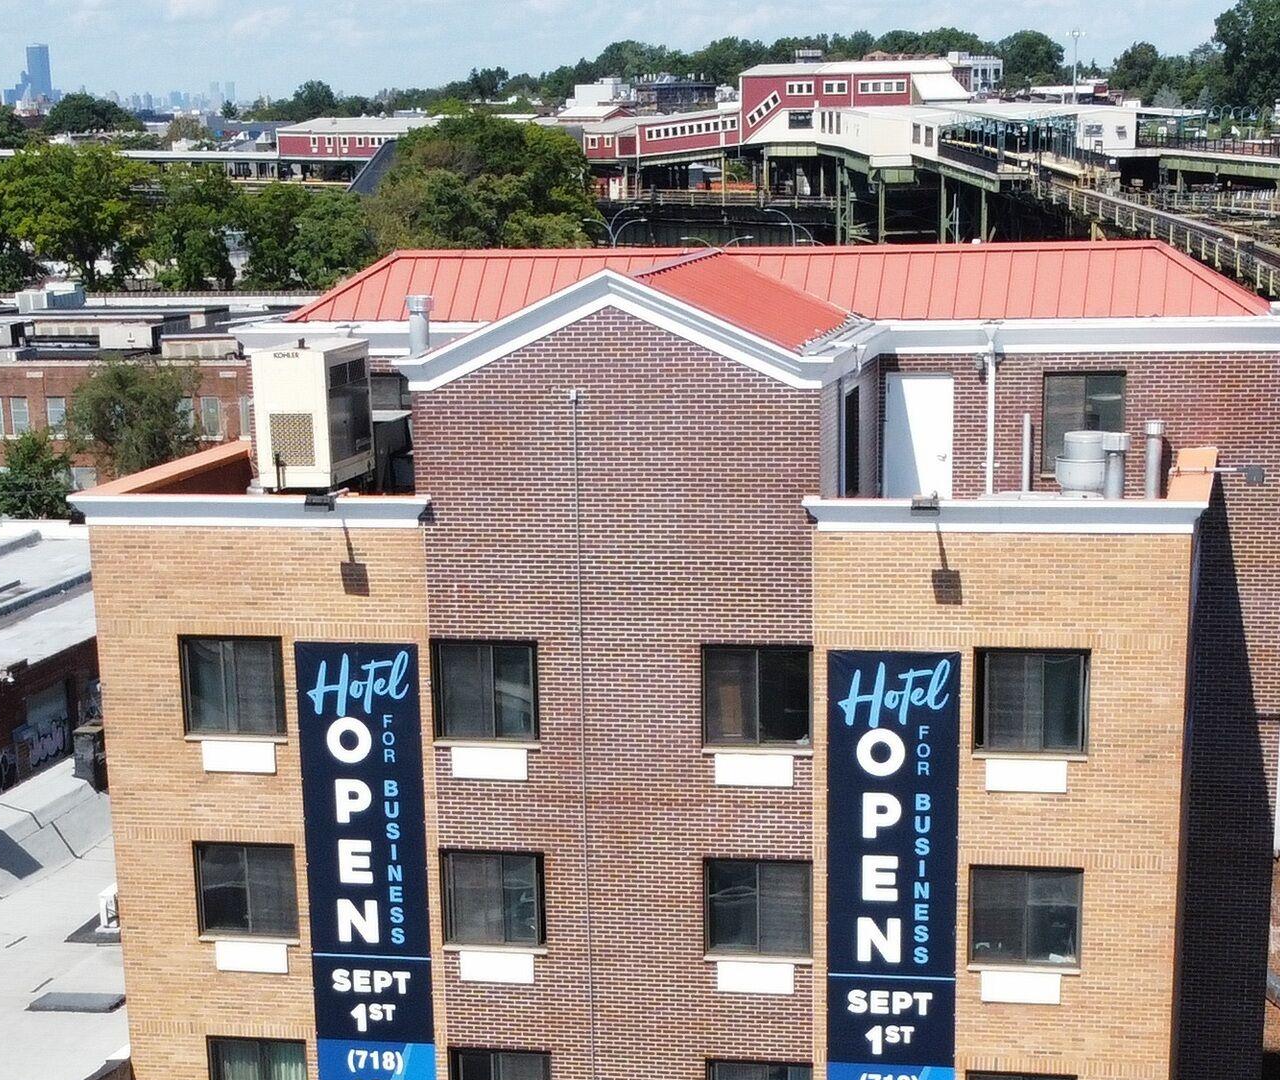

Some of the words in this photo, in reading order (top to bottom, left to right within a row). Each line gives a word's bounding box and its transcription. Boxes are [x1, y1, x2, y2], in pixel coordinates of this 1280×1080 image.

[306, 650, 410, 717] Hotel
[837, 659, 951, 728] Hotel
[382, 714, 396, 763] FOR
[916, 725, 931, 776] FOR
[326, 716, 380, 944] OPEN
[855, 728, 906, 964] OPEN
[383, 779, 407, 945] BUSINESS
[913, 793, 931, 964] BUSINESS
[331, 968, 411, 995] SEPT
[847, 989, 933, 1016] SEPT
[350, 1003, 396, 1032] 1ST
[864, 1025, 915, 1055] 1ST
[347, 1049, 404, 1074] (718)
